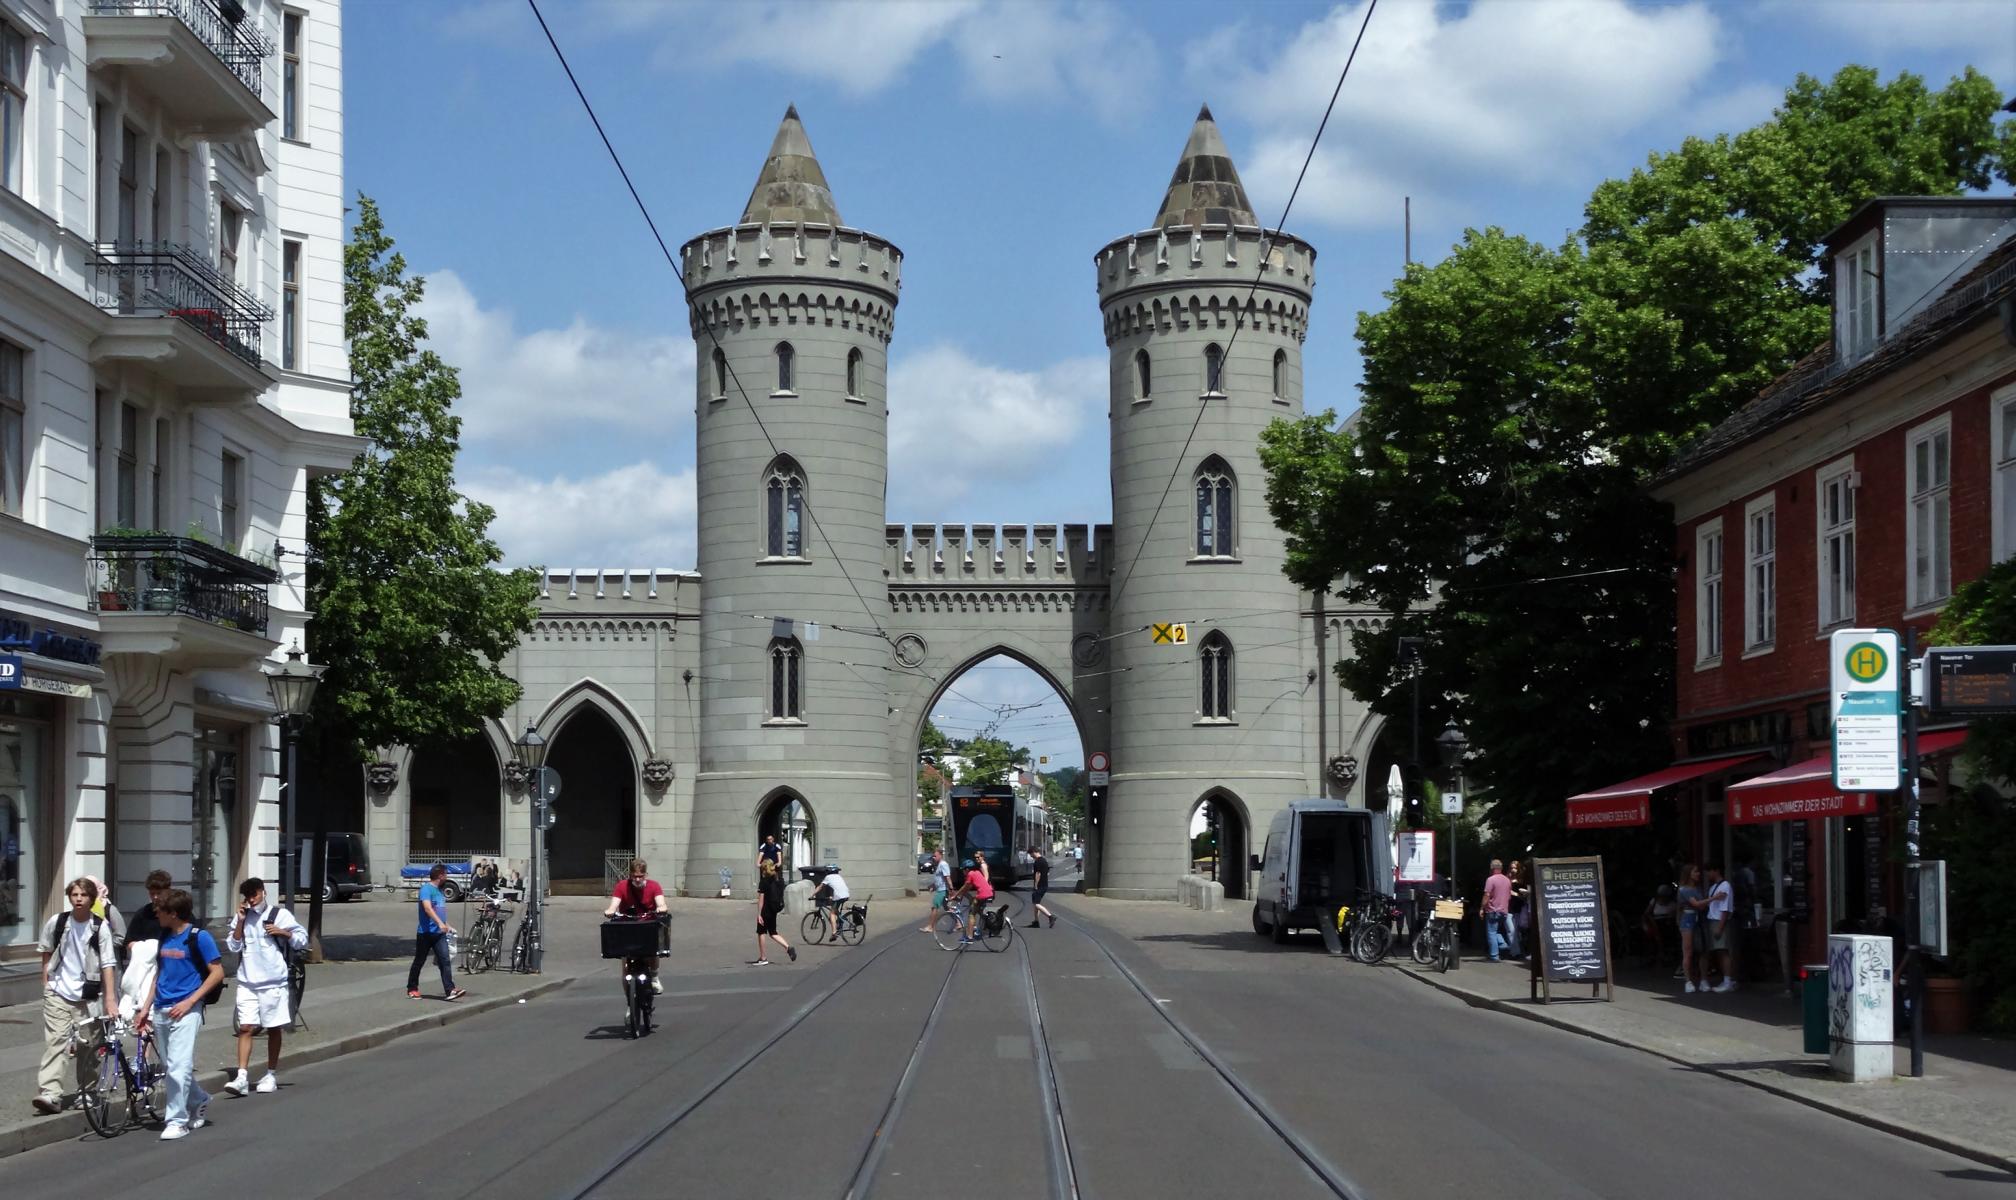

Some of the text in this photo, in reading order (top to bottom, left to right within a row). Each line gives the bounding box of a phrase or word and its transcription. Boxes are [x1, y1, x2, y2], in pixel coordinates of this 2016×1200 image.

[1175, 627, 1184, 642] 2
[1858, 651, 1875, 674] H
[1752, 796, 1845, 817] DAS WOHNZIMMER DER STADT
[1576, 809, 1638, 824] DAS WOHNZIMMER DER STADT
[1554, 871, 1595, 880] HEIDER
